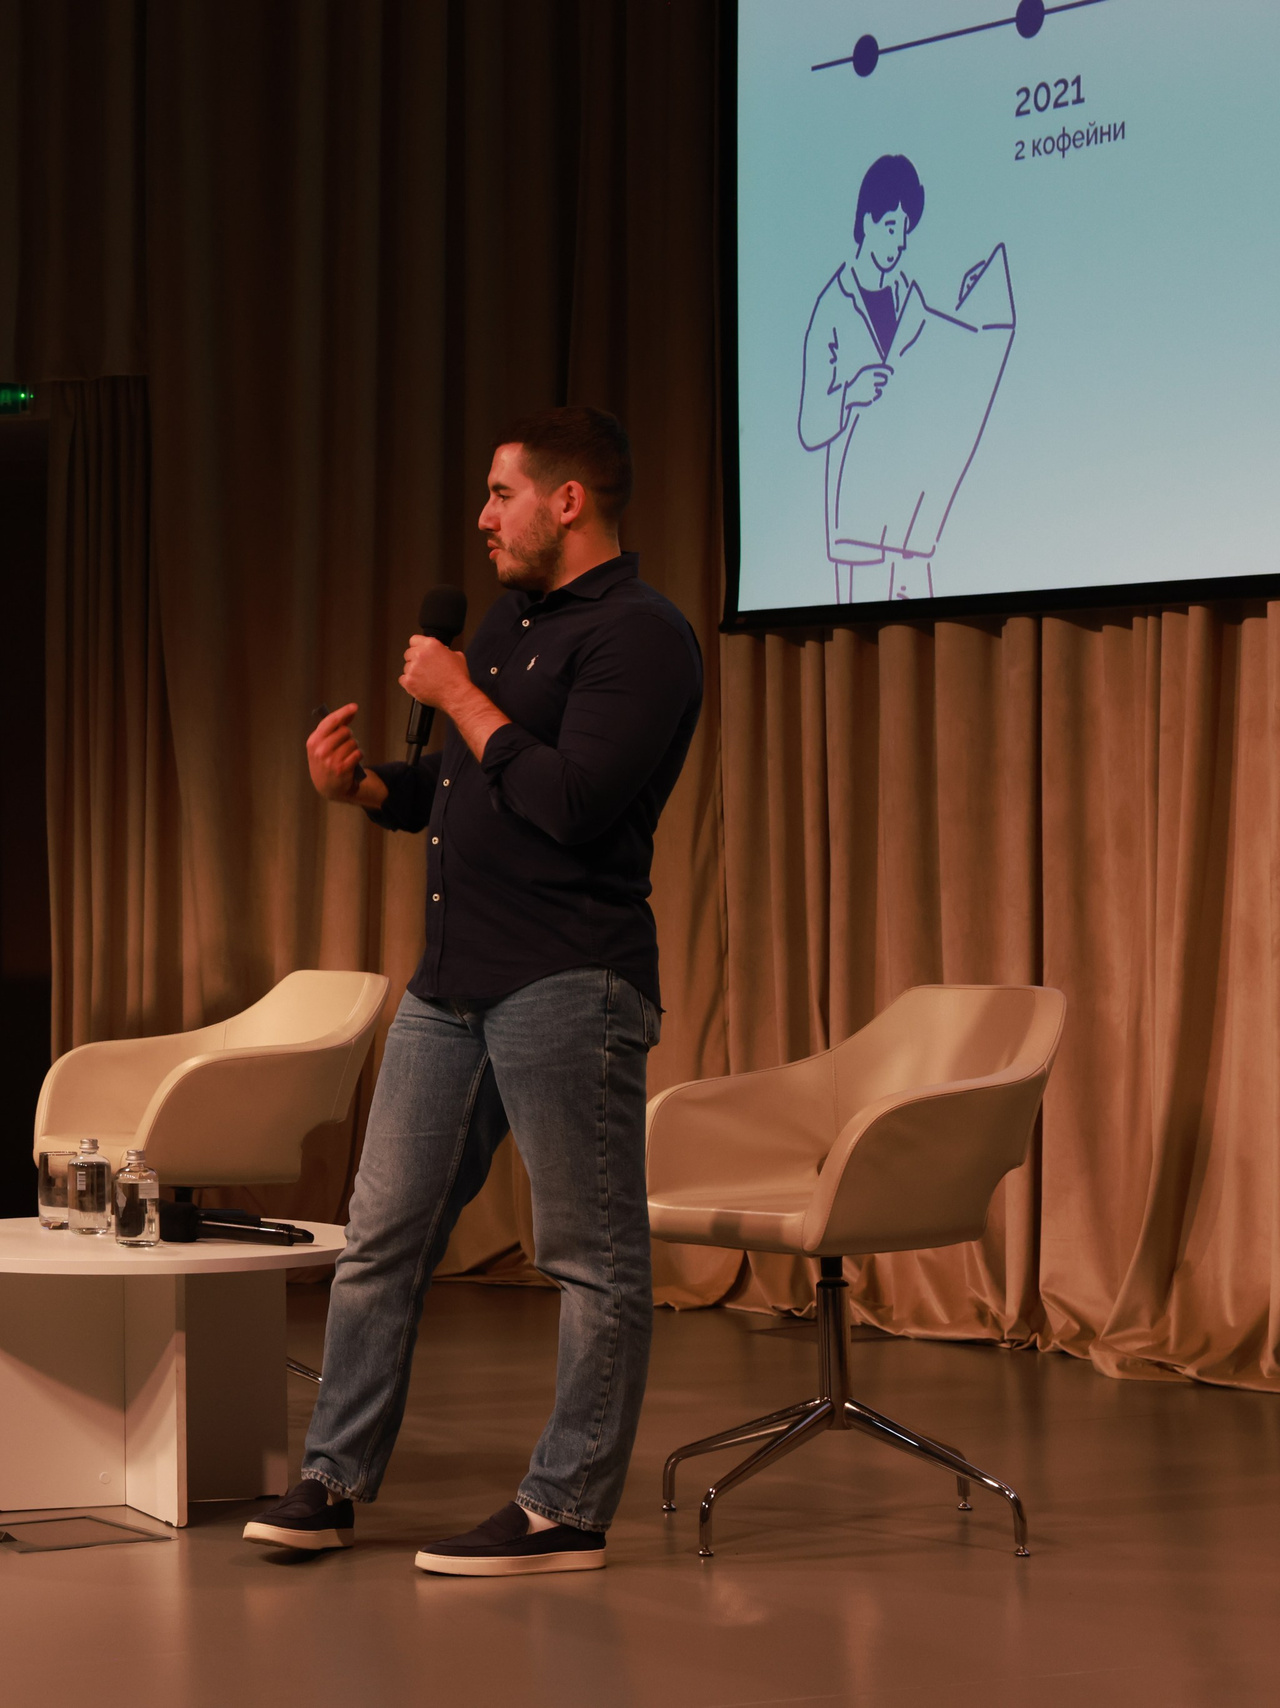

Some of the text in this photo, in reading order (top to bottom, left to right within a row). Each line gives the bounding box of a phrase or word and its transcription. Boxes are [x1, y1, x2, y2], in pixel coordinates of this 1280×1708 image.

[1015, 74, 1085, 117] 2021
[1015, 121, 1125, 161] 2 кофейни
